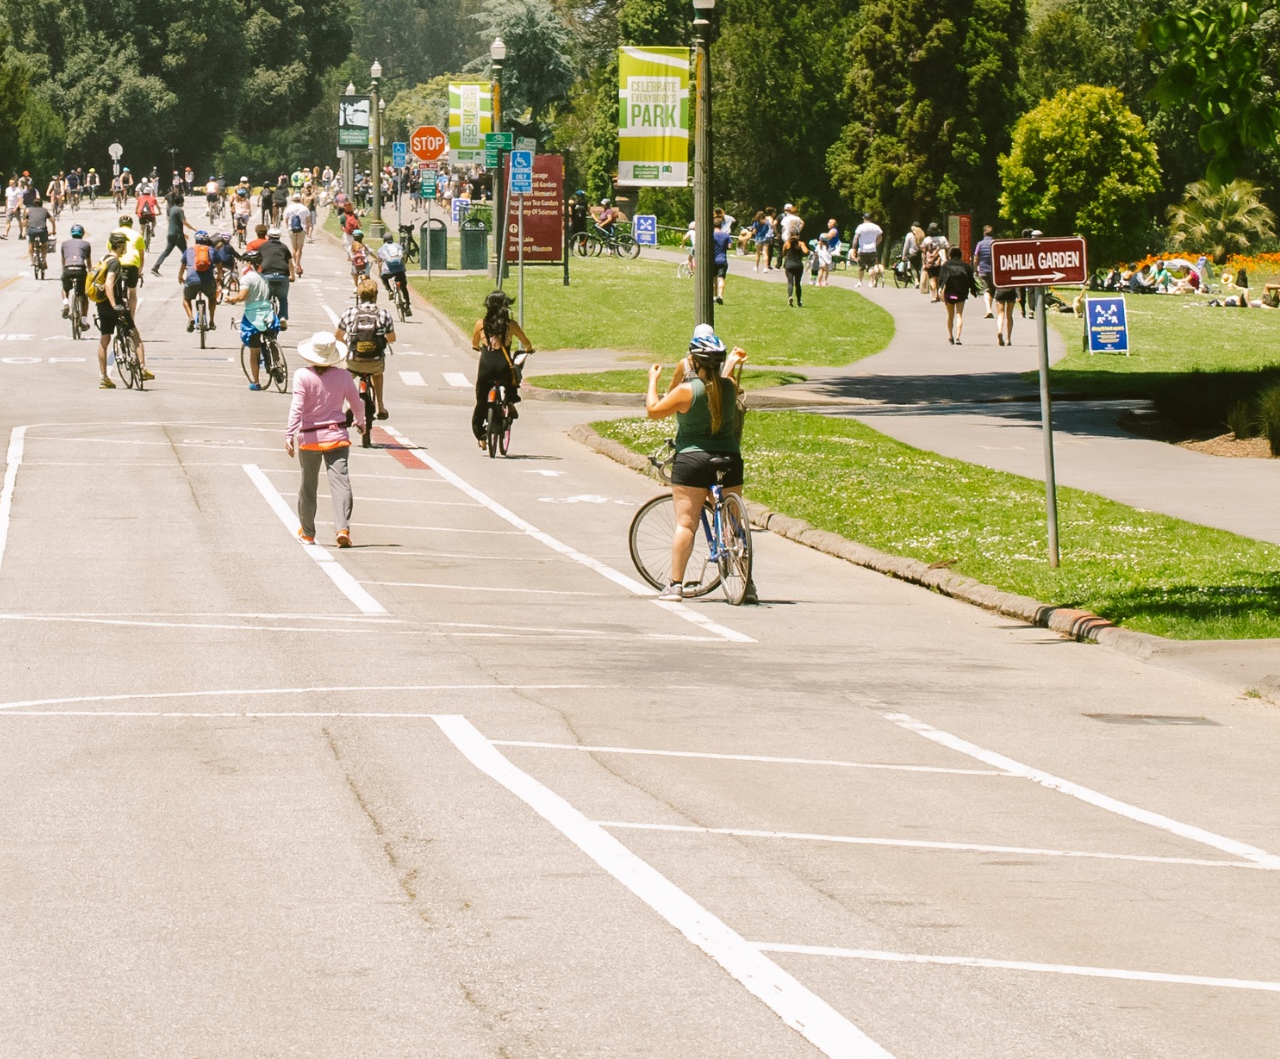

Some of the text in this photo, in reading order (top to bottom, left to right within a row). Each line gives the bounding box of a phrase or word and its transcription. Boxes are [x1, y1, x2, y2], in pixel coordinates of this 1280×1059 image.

[631, 81, 677, 93] CELEBRATE
[631, 93, 677, 103] EVERYBODY'S
[631, 104, 677, 128] PARK
[462, 124, 478, 138] 150
[413, 136, 443, 151] STOP
[1000, 251, 1080, 271] DAHLIA GARDEN
